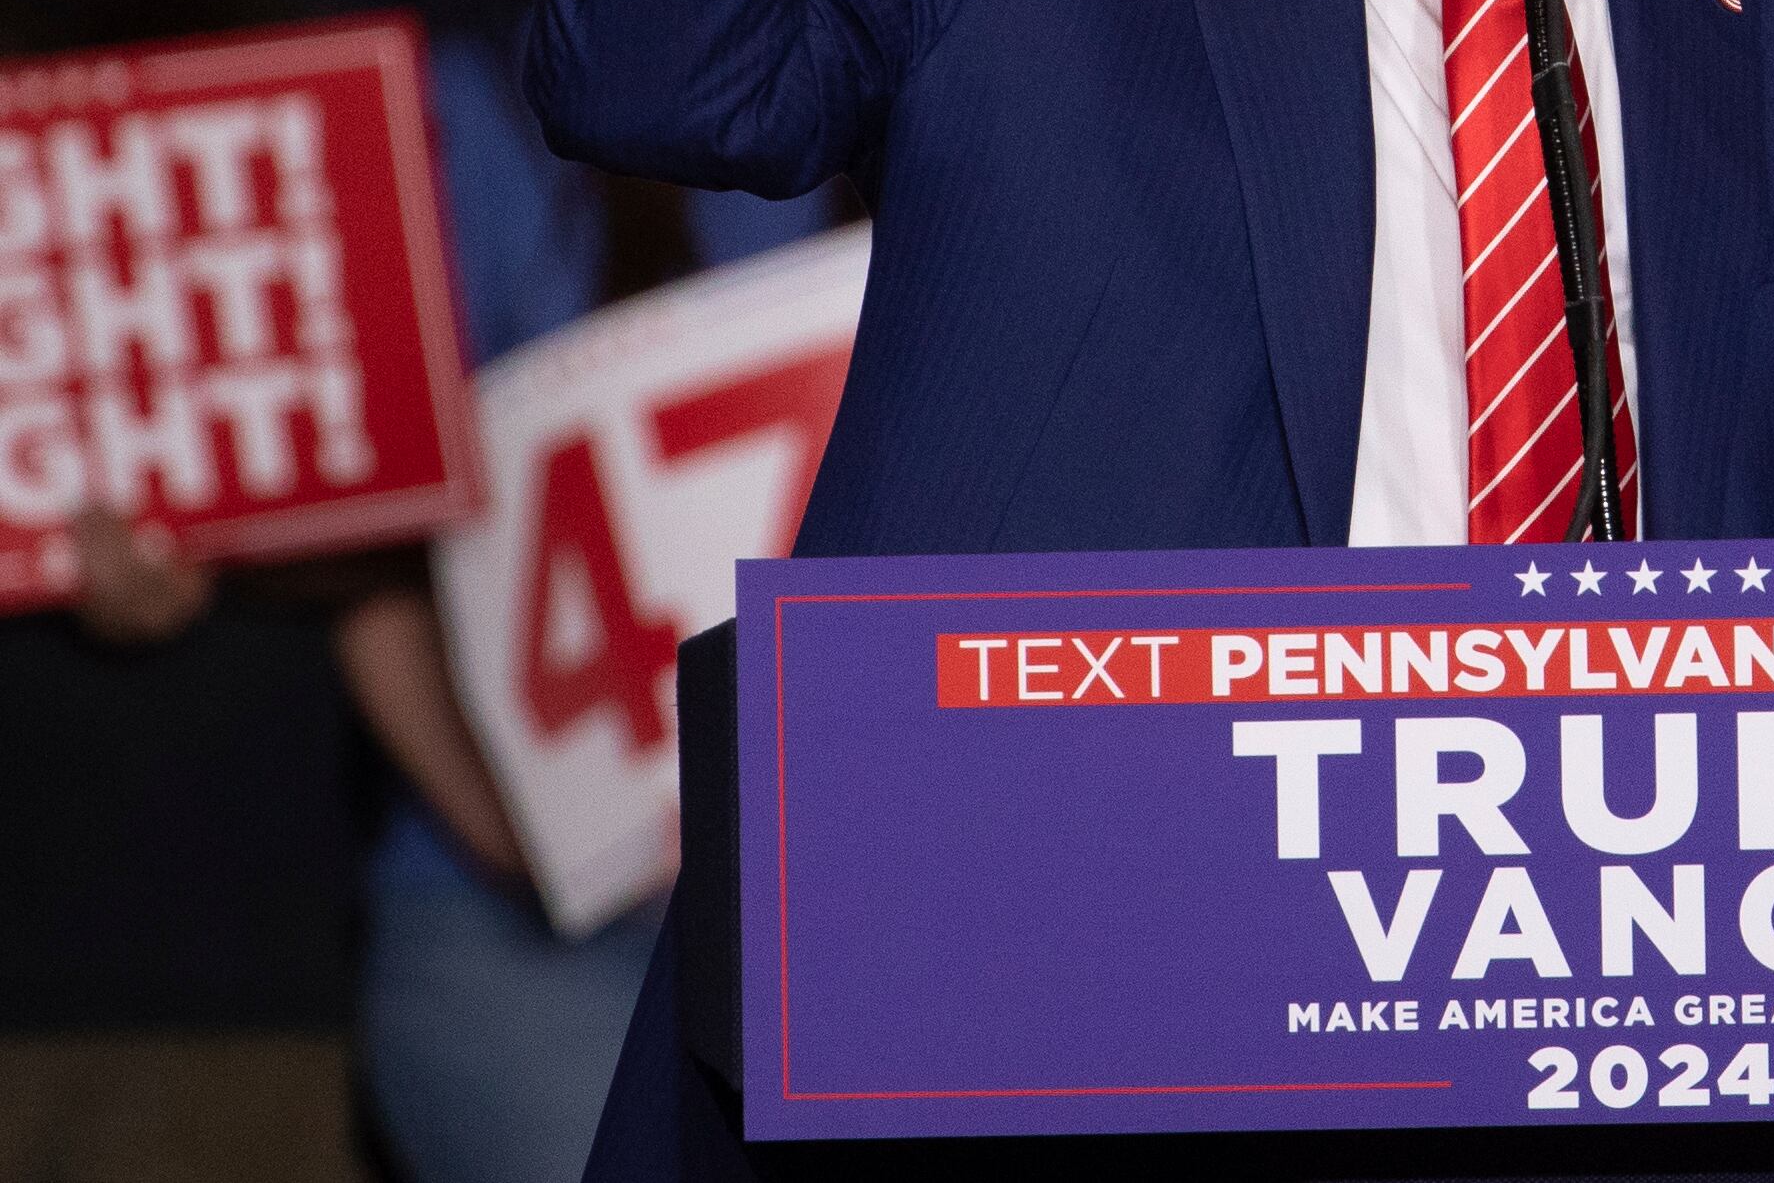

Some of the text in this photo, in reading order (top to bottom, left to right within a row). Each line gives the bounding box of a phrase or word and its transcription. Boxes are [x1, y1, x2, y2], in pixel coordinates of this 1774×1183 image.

[959, 635, 1180, 701] TEXT
[1288, 1000, 1420, 1033] MAKE
[1438, 996, 1655, 1031] AMERICA
